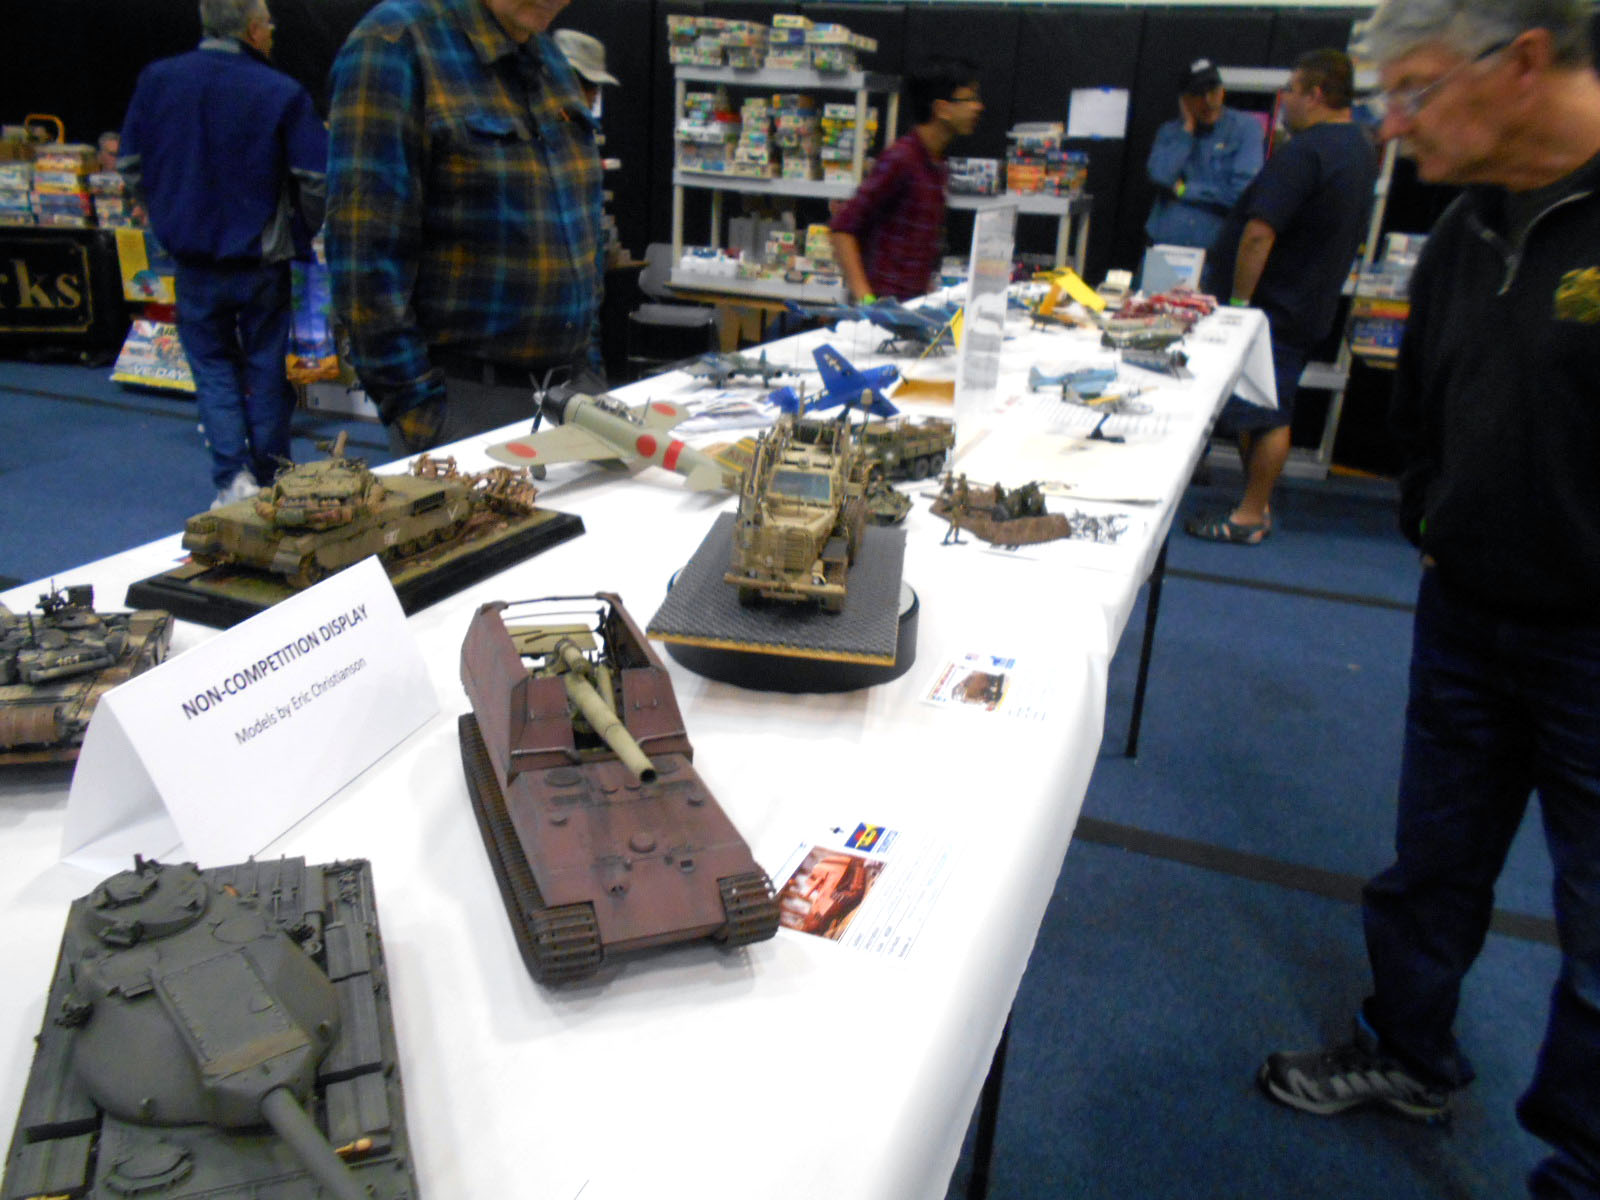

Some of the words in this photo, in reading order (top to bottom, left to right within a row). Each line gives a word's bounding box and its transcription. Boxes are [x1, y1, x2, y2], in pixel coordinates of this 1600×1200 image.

[181, 631, 320, 720] NON-COMPETITION
[318, 603, 369, 642] DISPLAY
[234, 713, 278, 744] Models
[276, 704, 292, 718] by
[291, 691, 312, 710] Eric
[311, 656, 367, 698] Christianson
